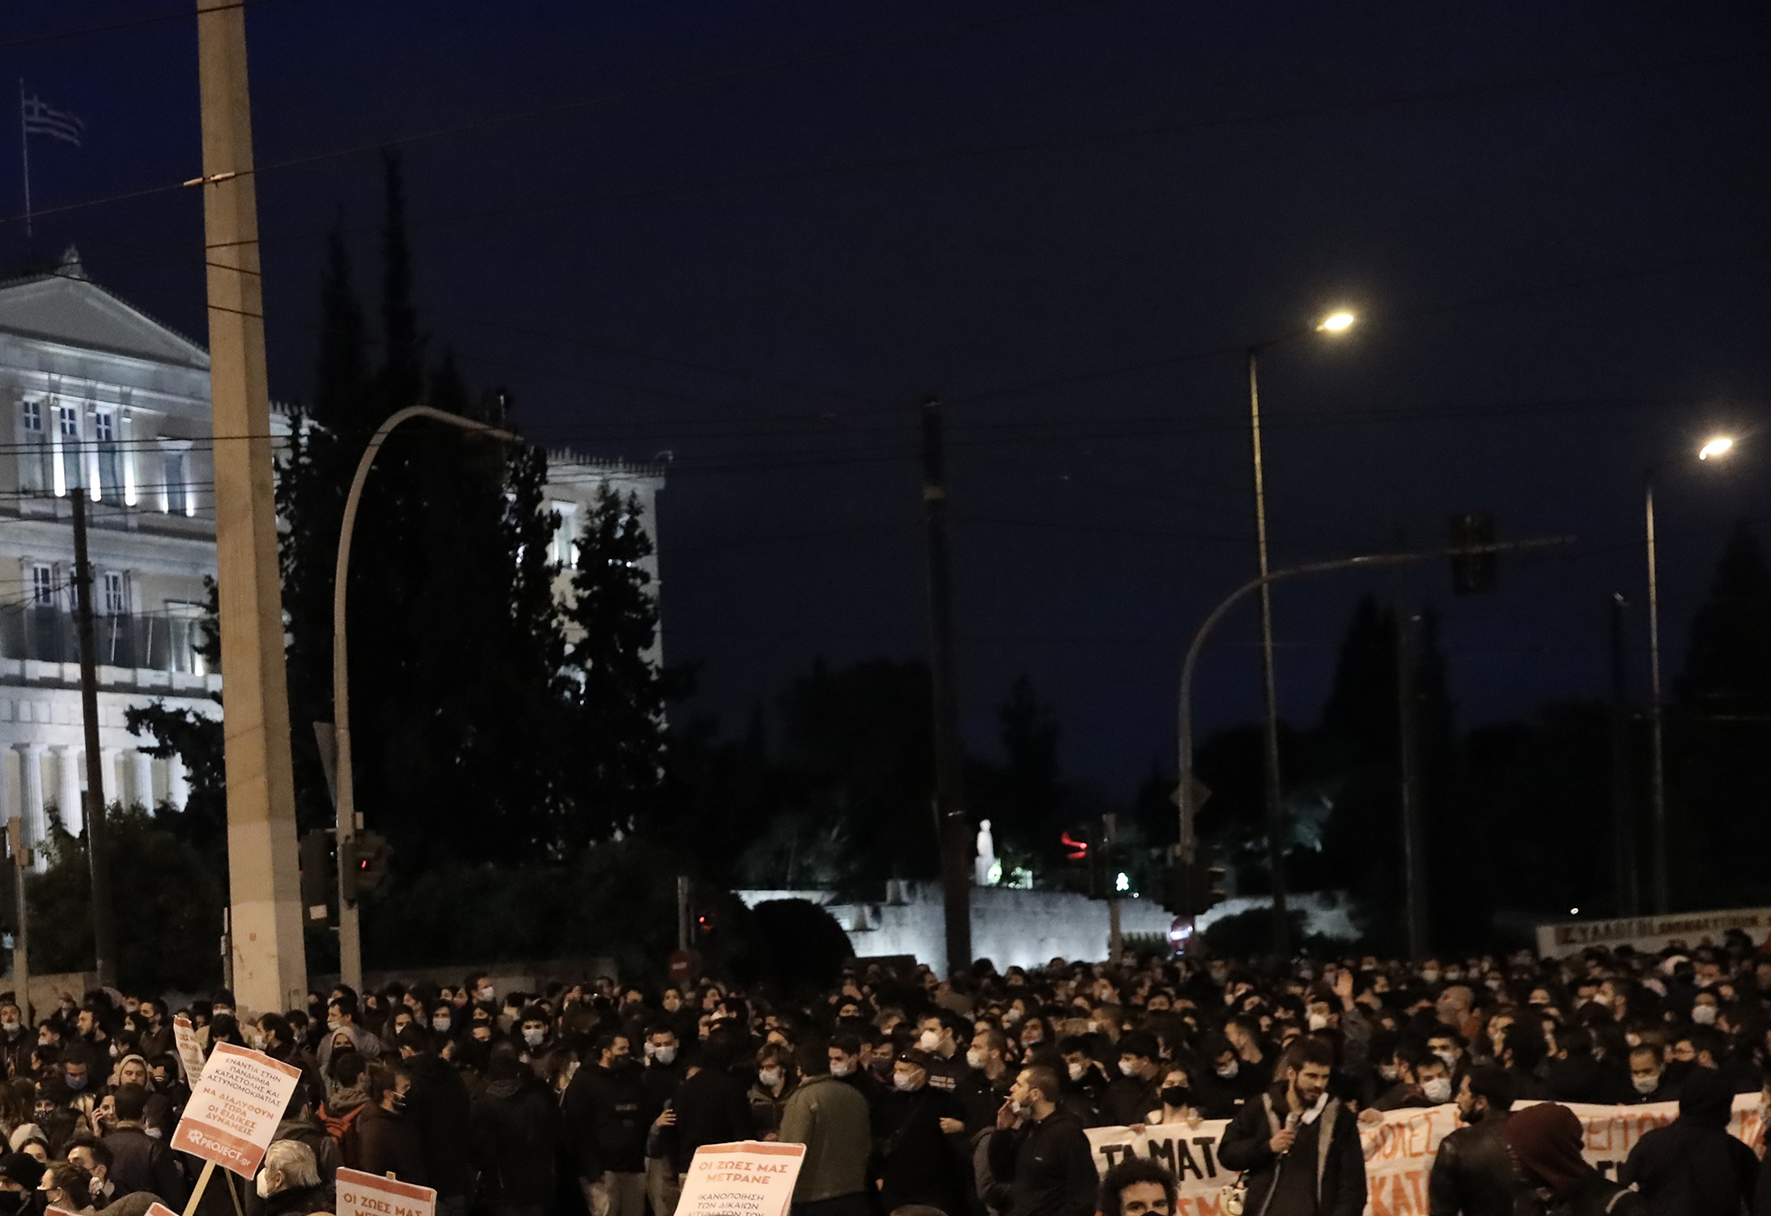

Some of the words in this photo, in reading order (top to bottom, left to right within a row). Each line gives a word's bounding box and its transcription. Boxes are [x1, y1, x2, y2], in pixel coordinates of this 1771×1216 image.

[225, 1057, 259, 1074] ΕΝΑΝΤΙΑ
[259, 1070, 282, 1083] ΣΤΗΝ
[229, 1065, 270, 1087] ΠΑΝΔΗΜΙΑ
[207, 1074, 282, 1107] ΑΣΤΥΝΟΜΟΚΡΑΤΙΑΣ
[214, 1068, 266, 1094] ΚΑΤΑΣΤΟΛΗΣ
[266, 1089, 280, 1098] ΚΑΙ
[203, 1086, 216, 1097] ΝΑ
[219, 1092, 275, 1120] ΔΙΑΛΥΘΟΥΝ
[224, 1102, 247, 1118] ΤΩΡΑ
[206, 1112, 253, 1136] ΔΥΝΑΜΕΙΣ
[208, 1104, 219, 1113] ΟΙ
[220, 1109, 257, 1129] ΕΙΔΙΚΕΣ
[698, 1161, 713, 1171] ΟΙ
[716, 1160, 755, 1171] ΖΩΕΣ
[756, 1164, 789, 1174] ΜΑΣ
[706, 1172, 771, 1185] ΜΕΤΡΑΝΕ
[343, 1192, 356, 1205] ΟΙ
[360, 1195, 391, 1215] ΖΩΕΣ
[698, 1192, 765, 1201] ΙΚΑΝΟΠΟΙΗΣΗ
[718, 1202, 759, 1210] ΔΙΚΑΙΩΝ
